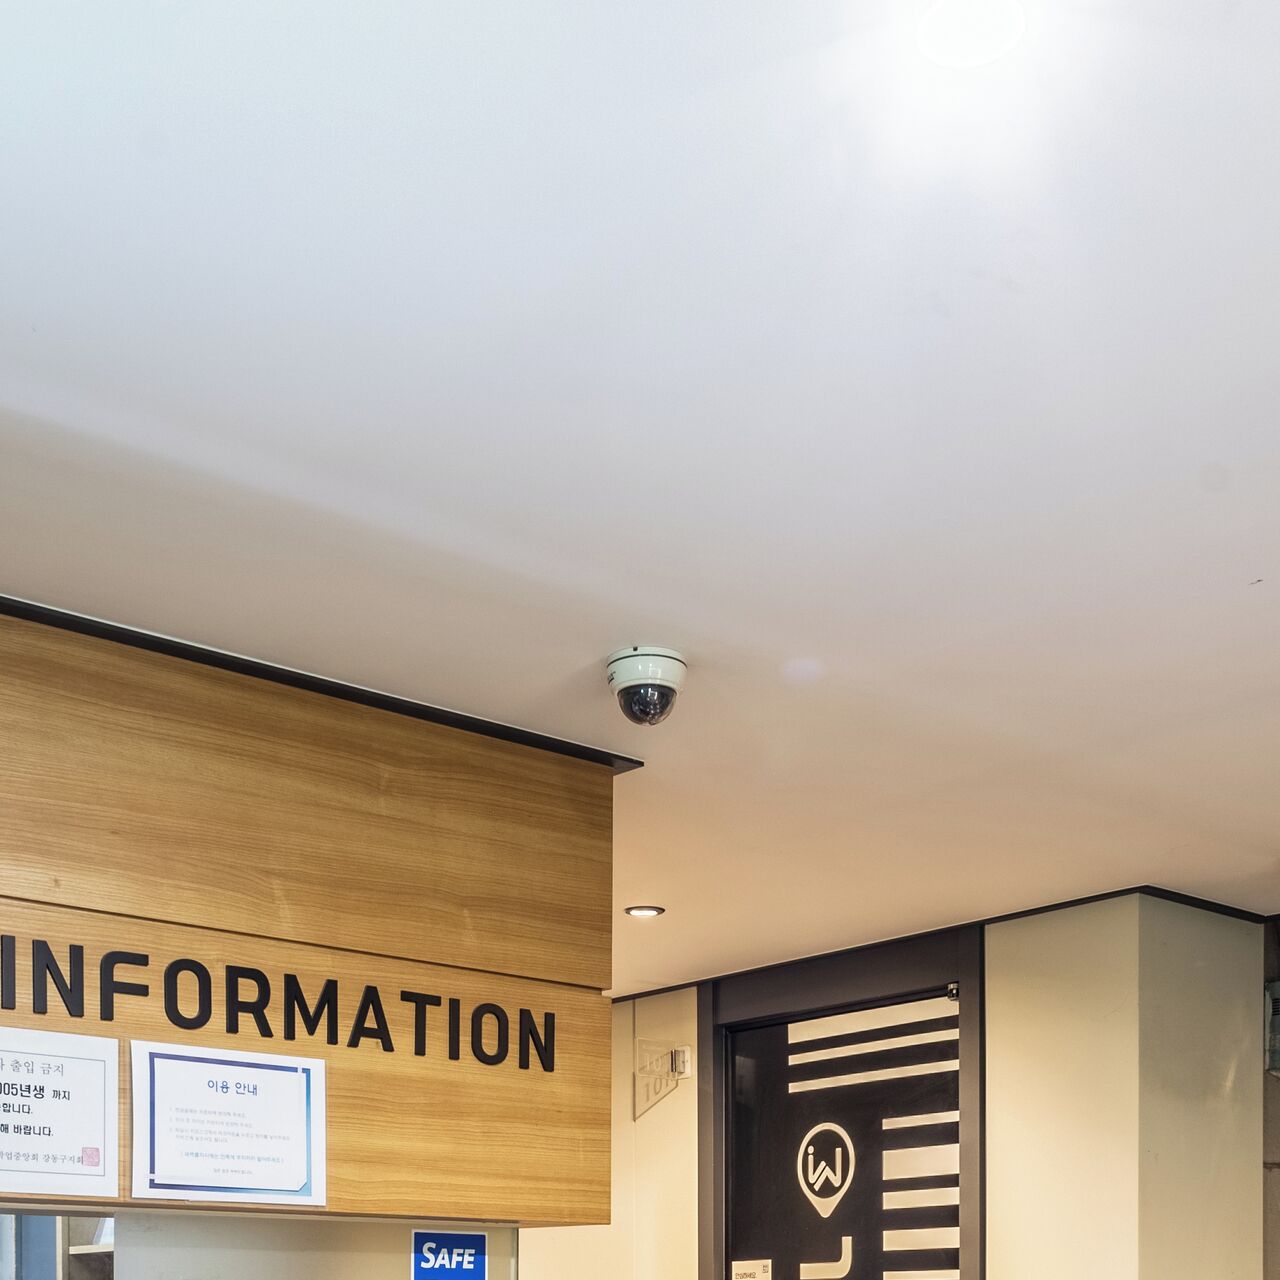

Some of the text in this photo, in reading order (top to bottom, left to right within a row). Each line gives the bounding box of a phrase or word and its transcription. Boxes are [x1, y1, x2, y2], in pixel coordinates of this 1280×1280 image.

[0, 934, 555, 1073] INFORMATION
[10, 1058, 34, 1075] 출입
[40, 1062, 64, 1077] 금지
[52, 1089, 70, 1101] 까지
[207, 1079, 258, 1096] 이용 안내
[13, 1123, 54, 1137] 바랍니다.
[421, 1242, 475, 1270] SAFE
